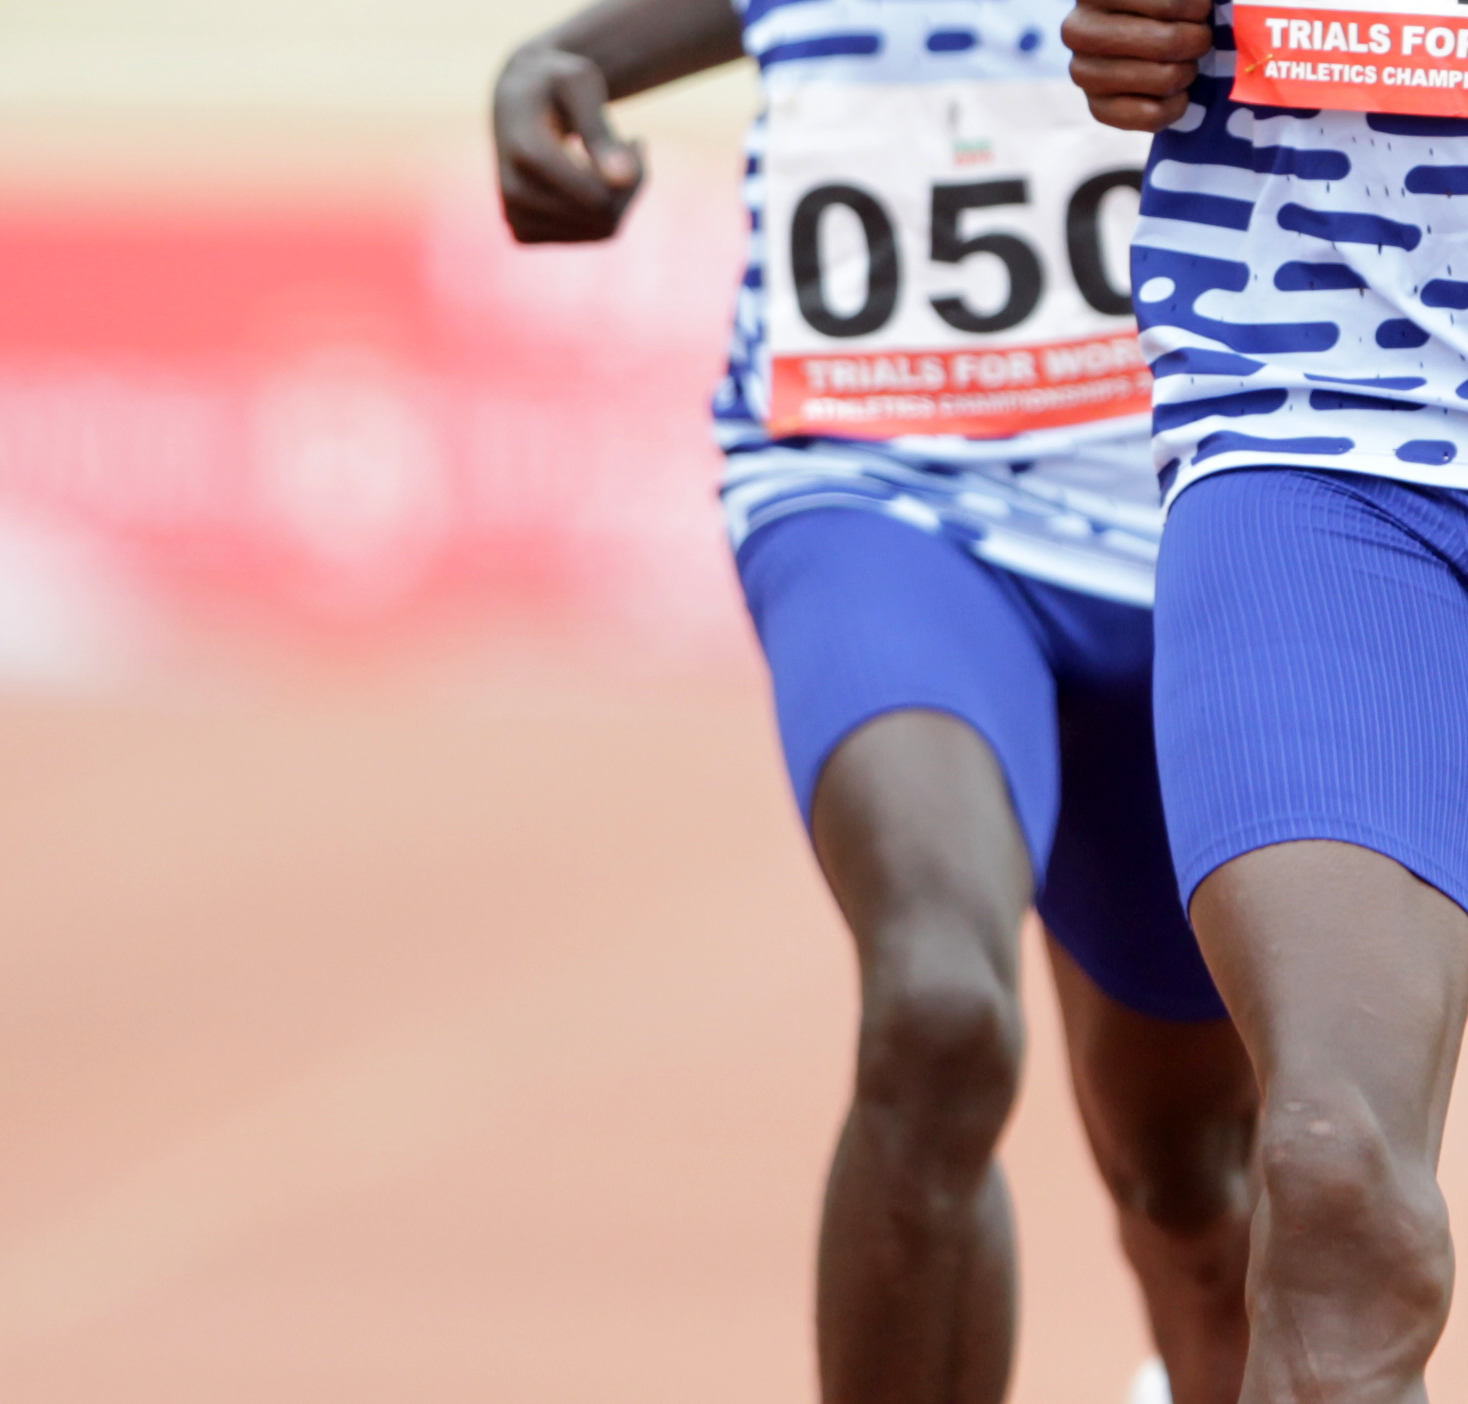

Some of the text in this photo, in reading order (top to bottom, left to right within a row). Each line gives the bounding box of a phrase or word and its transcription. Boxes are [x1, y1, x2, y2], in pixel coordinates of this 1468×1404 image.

[1265, 18, 1392, 54] TRIALS
[1264, 59, 1378, 84] ATHLETICS
[806, 354, 946, 395] TRIALS
[952, 350, 1037, 389] FOR
